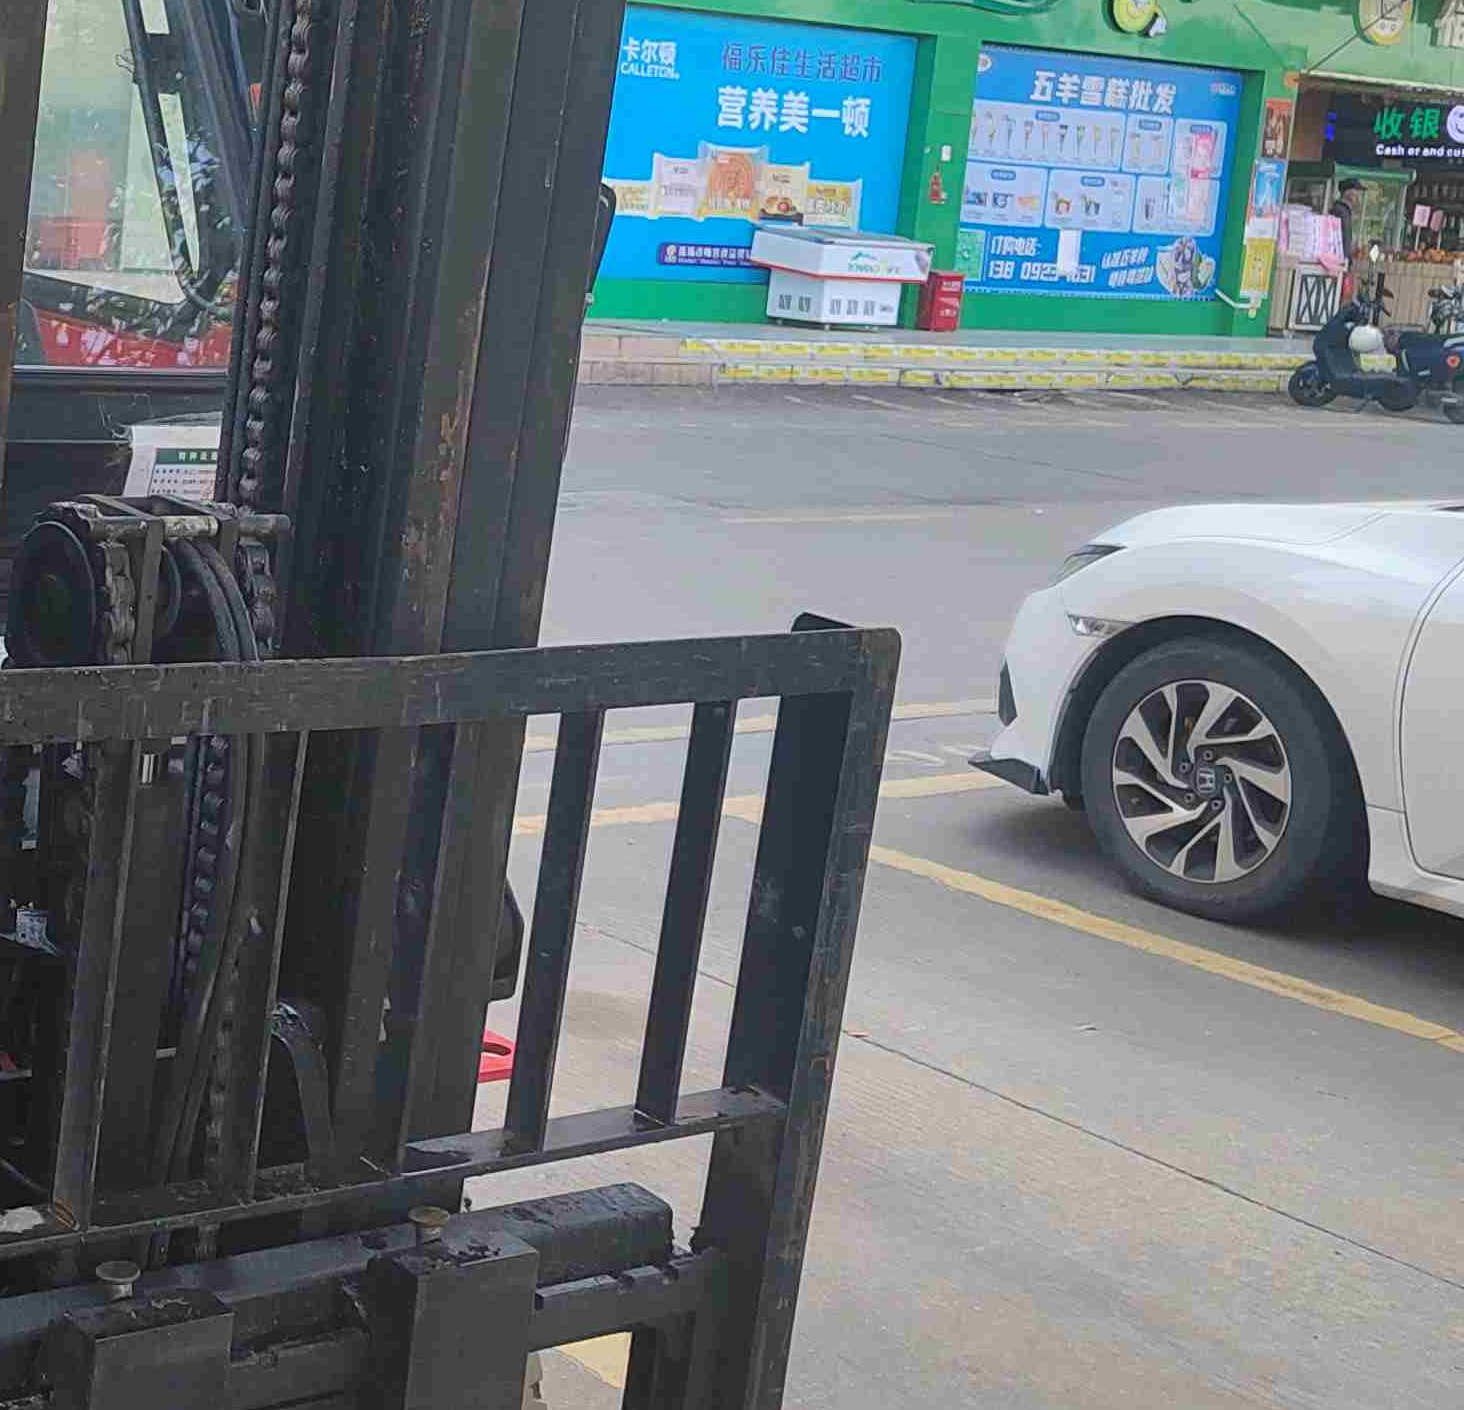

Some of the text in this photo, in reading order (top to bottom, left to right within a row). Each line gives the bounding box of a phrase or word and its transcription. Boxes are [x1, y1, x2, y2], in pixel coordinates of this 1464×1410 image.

[722, 42, 882, 83] 福乐佳生活超市
[717, 84, 873, 138] 营养美一顿
[1030, 70, 1177, 114] 五羊雪糕批发
[1374, 107, 1441, 141] 收银
[1376, 143, 1405, 156] Cash
[1422, 146, 1445, 157] and
